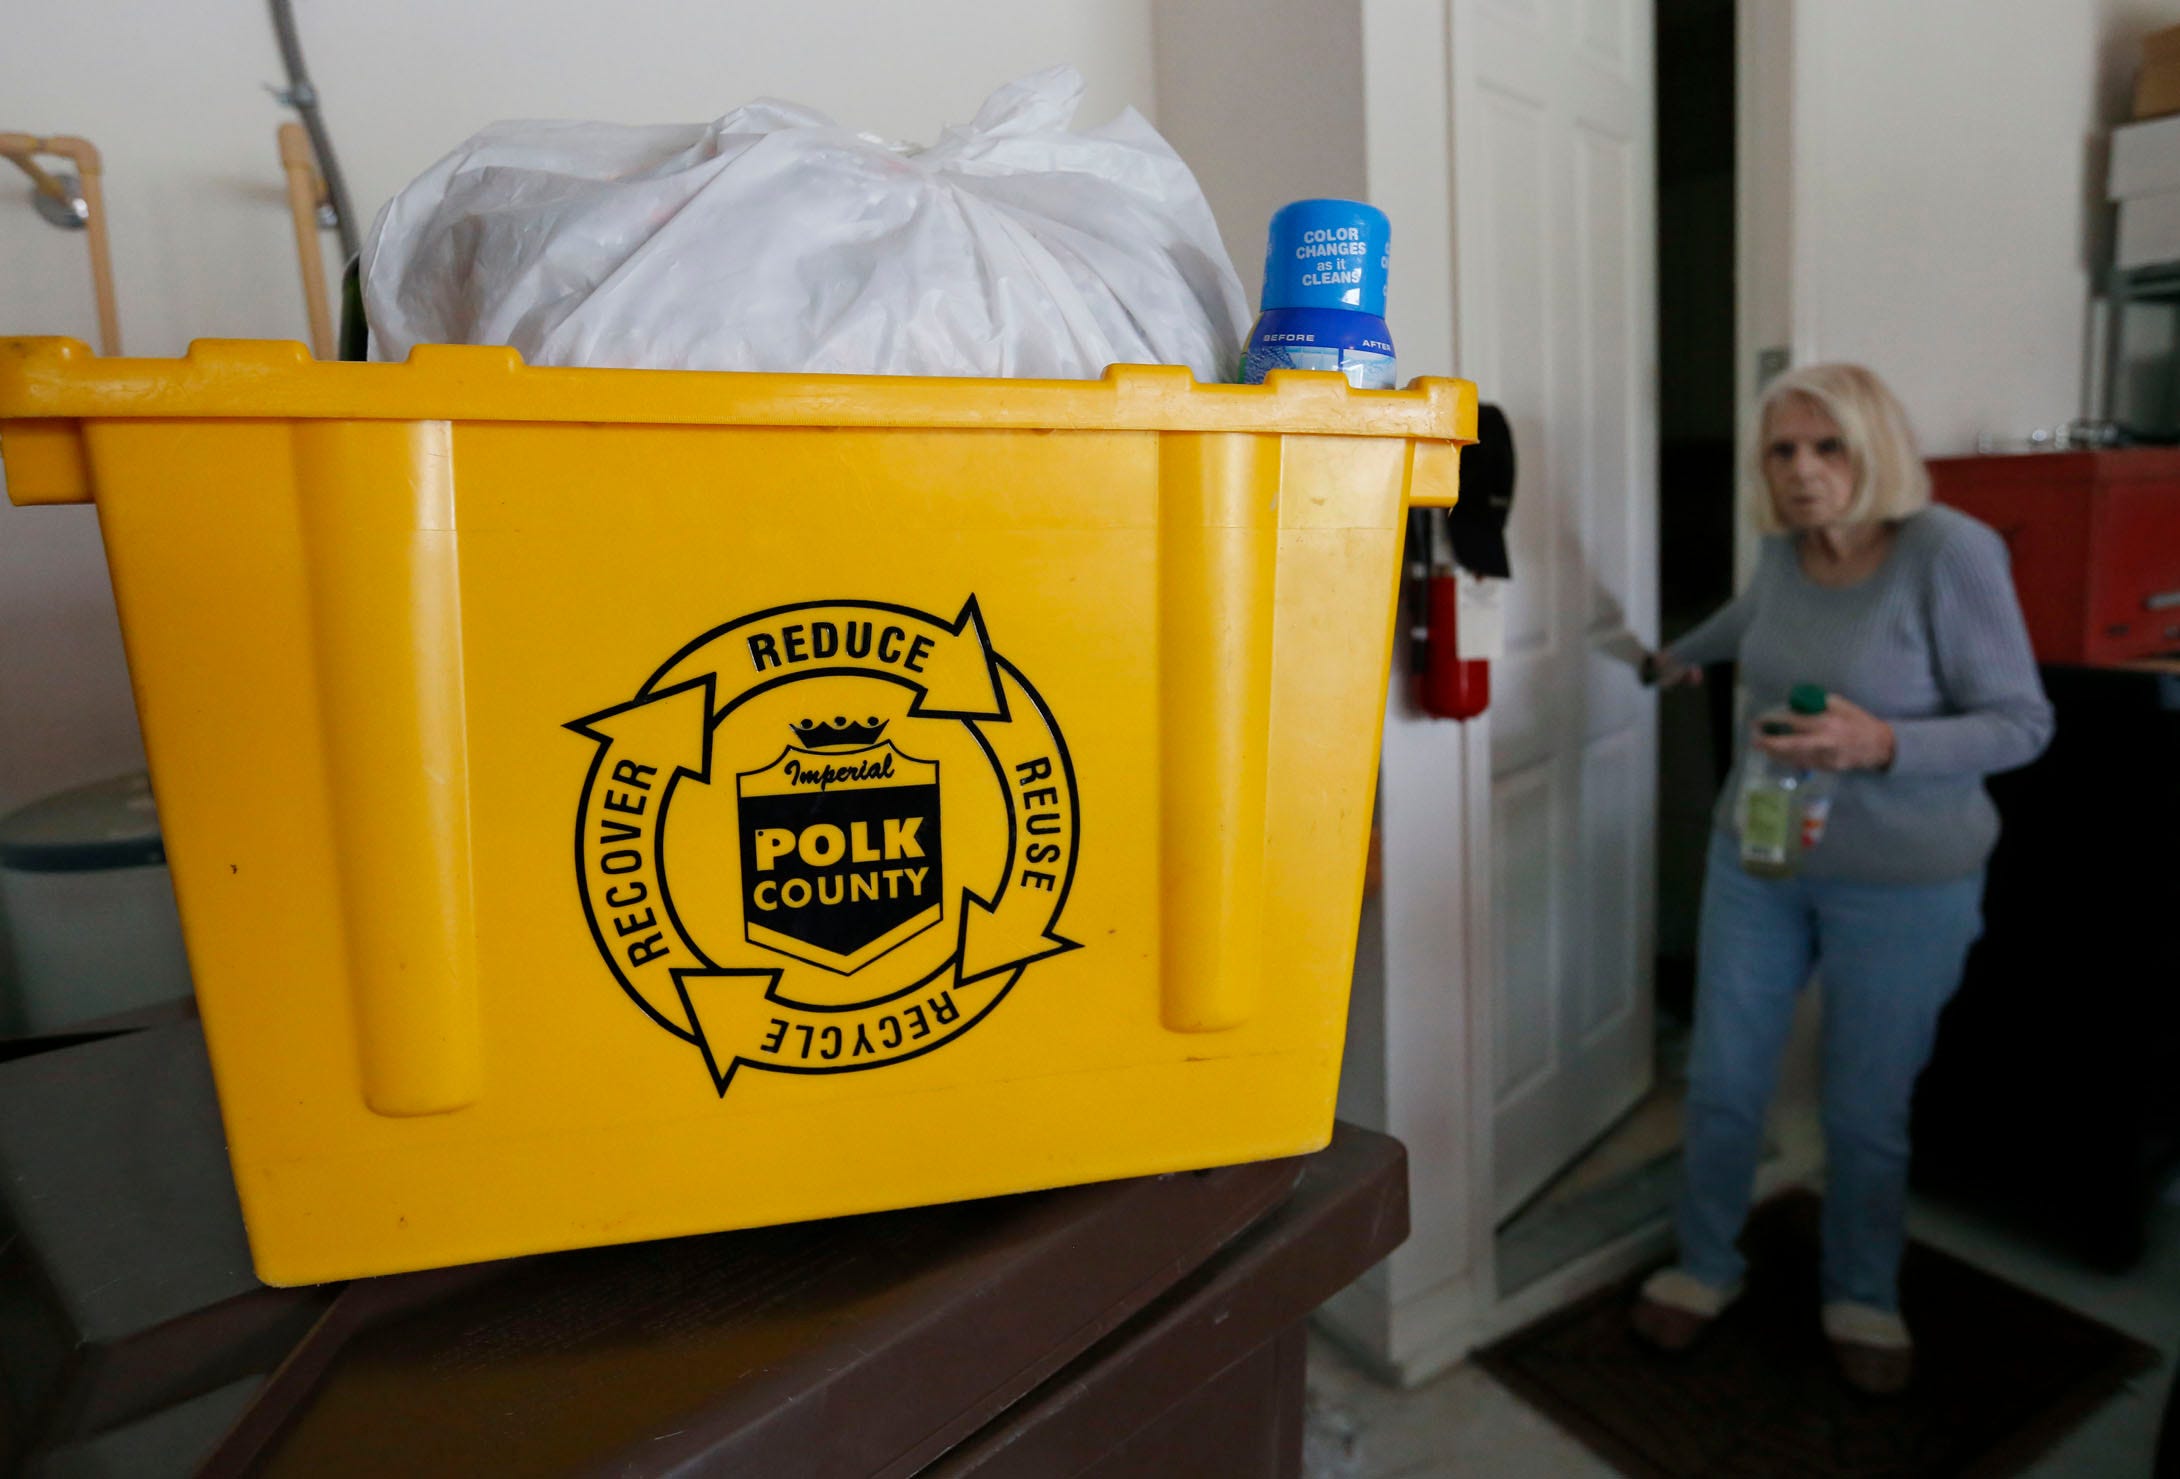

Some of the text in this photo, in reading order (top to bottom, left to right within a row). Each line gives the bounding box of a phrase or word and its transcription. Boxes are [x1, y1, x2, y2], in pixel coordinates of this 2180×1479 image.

[1296, 242, 1367, 260] CHANGES
[1304, 227, 1359, 244] COLOR
[1302, 270, 1362, 286] CLEANS
[1316, 258, 1346, 272] as it
[1263, 333, 1316, 342] BEFORE
[747, 620, 935, 672] REDUCE
[784, 752, 895, 792] Imperial
[753, 816, 926, 872] POLK
[1015, 756, 1062, 893] REUSE
[599, 758, 671, 968] RECOVER
[753, 867, 929, 912] COUNTY
[760, 990, 961, 1060] RECYCLE
